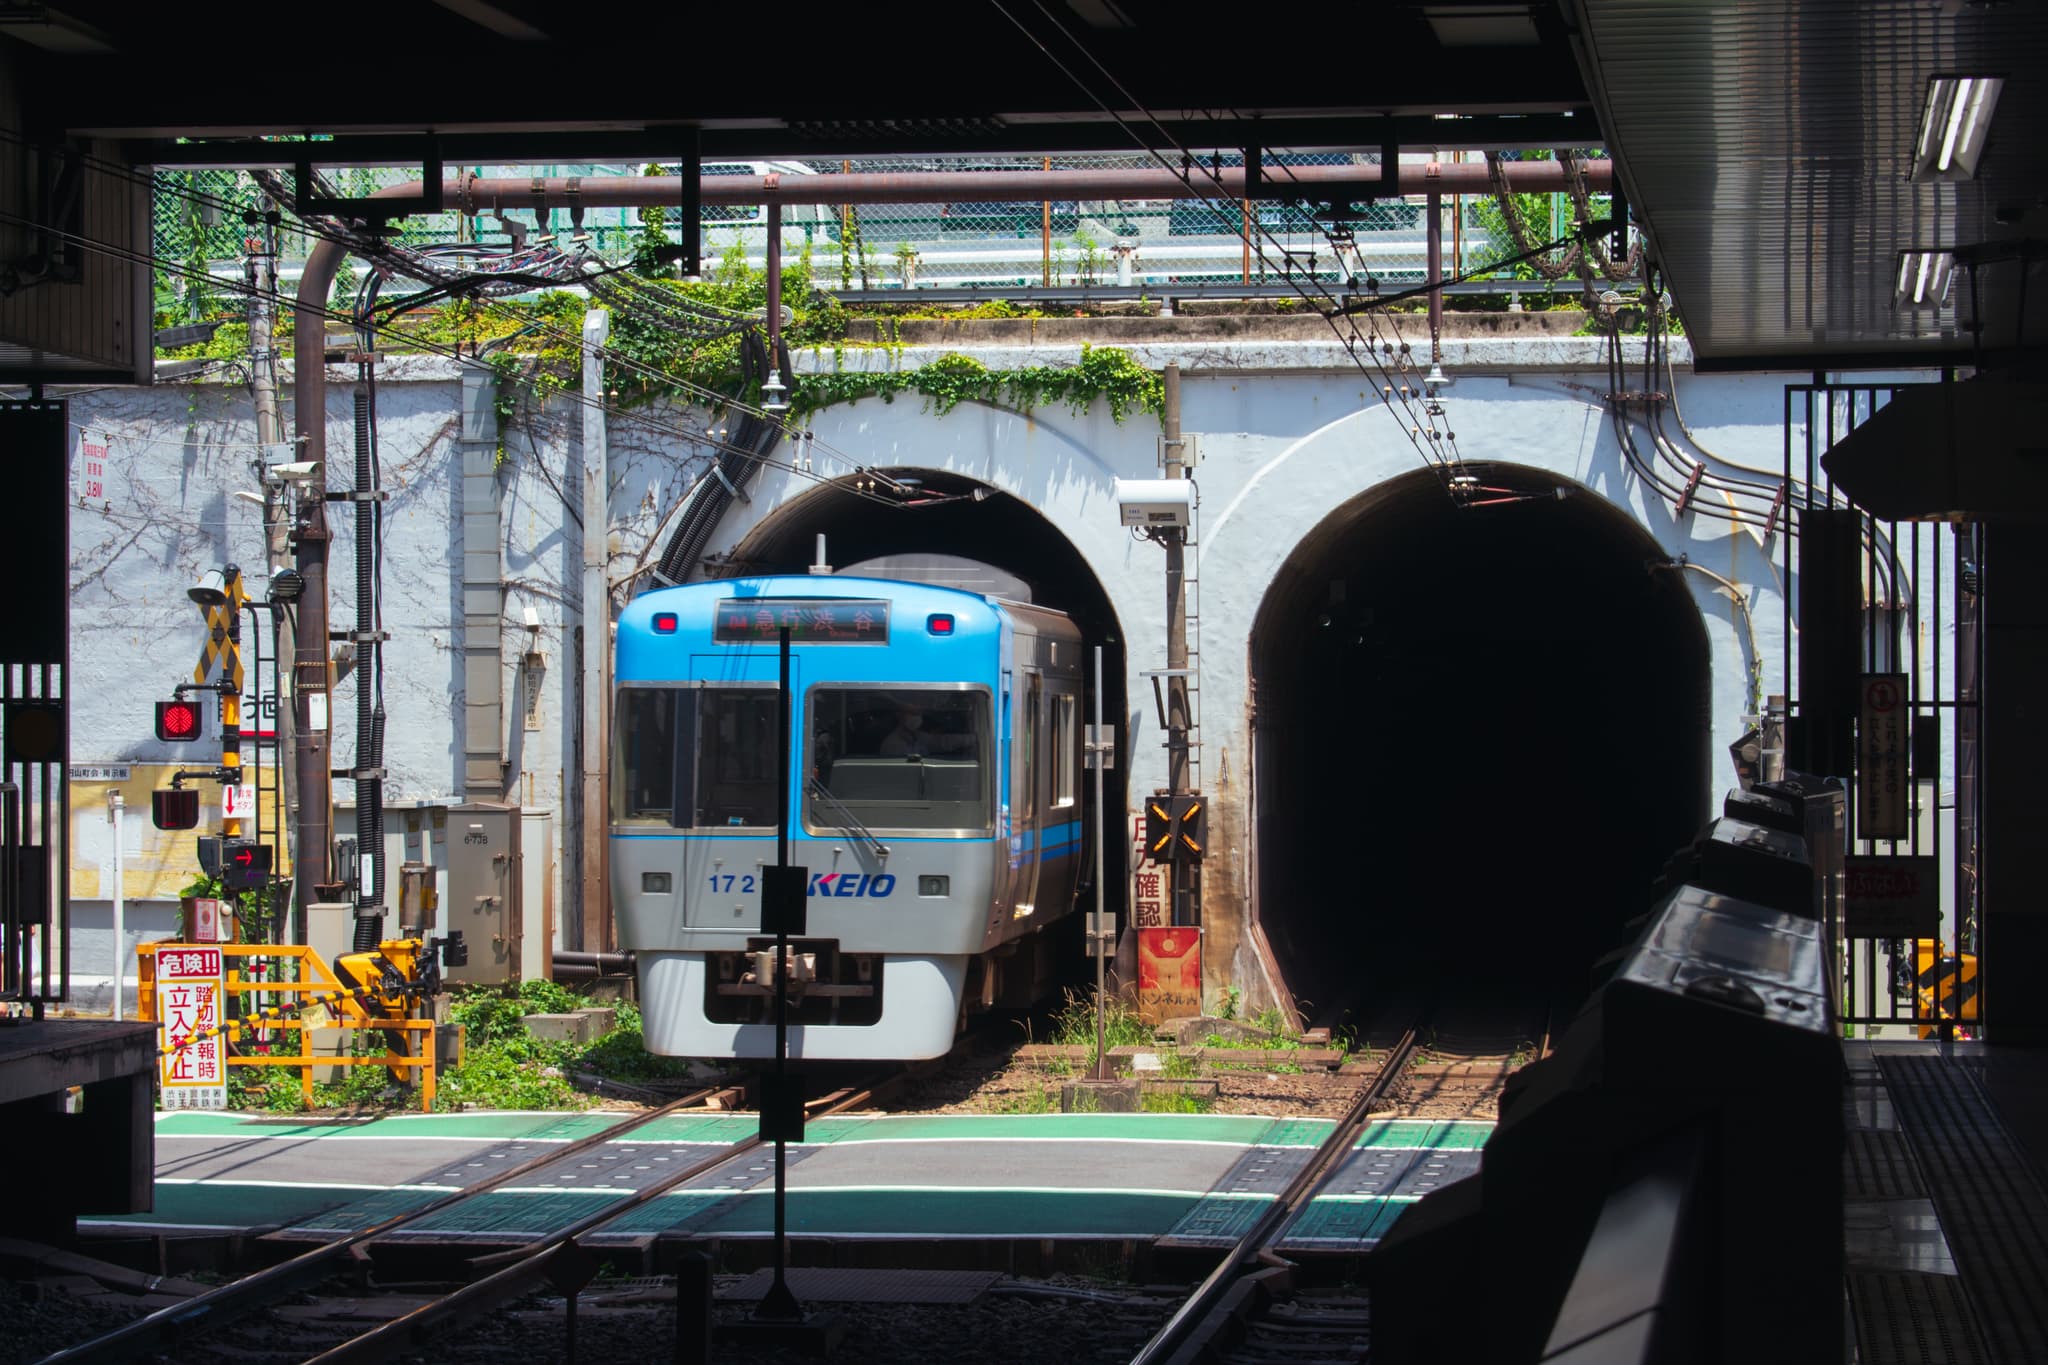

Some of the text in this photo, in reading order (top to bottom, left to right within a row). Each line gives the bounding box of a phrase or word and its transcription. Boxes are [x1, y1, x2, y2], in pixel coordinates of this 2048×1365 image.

[86, 480, 103, 498] 3.8M
[754, 609, 801, 632] 急行
[813, 609, 874, 632] 渋谷
[709, 873, 896, 898] 172 KEIO
[161, 953, 218, 974] 危険!!
[1140, 991, 1198, 1006] トンネル内
[168, 985, 194, 1080] 立入禁止
